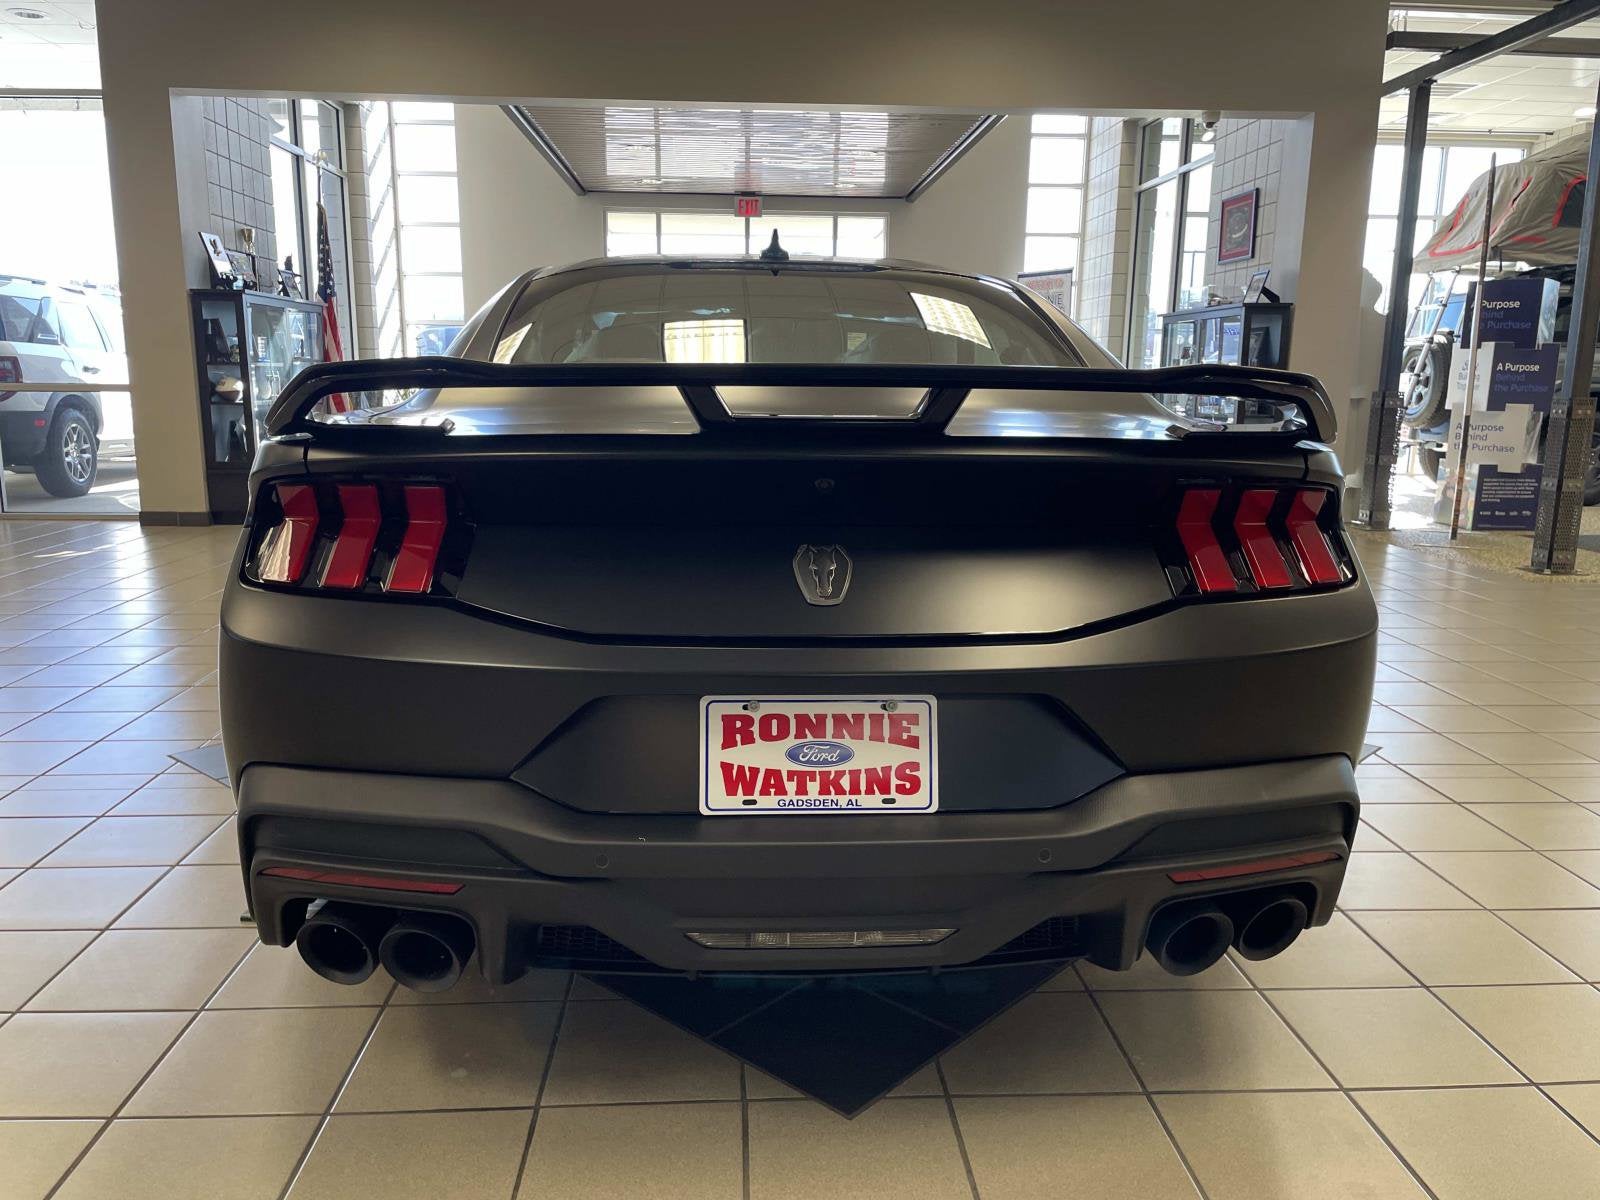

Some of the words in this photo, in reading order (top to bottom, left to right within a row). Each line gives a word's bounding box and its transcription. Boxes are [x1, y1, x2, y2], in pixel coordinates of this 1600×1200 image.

[738, 198, 759, 215] EXIT
[1496, 363, 1503, 371] A
[1504, 363, 1540, 372] Purpose
[1471, 443, 1515, 453] Purchase
[720, 713, 920, 750] RONNIE
[720, 760, 922, 797] WATKINS
[777, 798, 843, 809] GADSDEN,
[845, 798, 863, 807] AL
